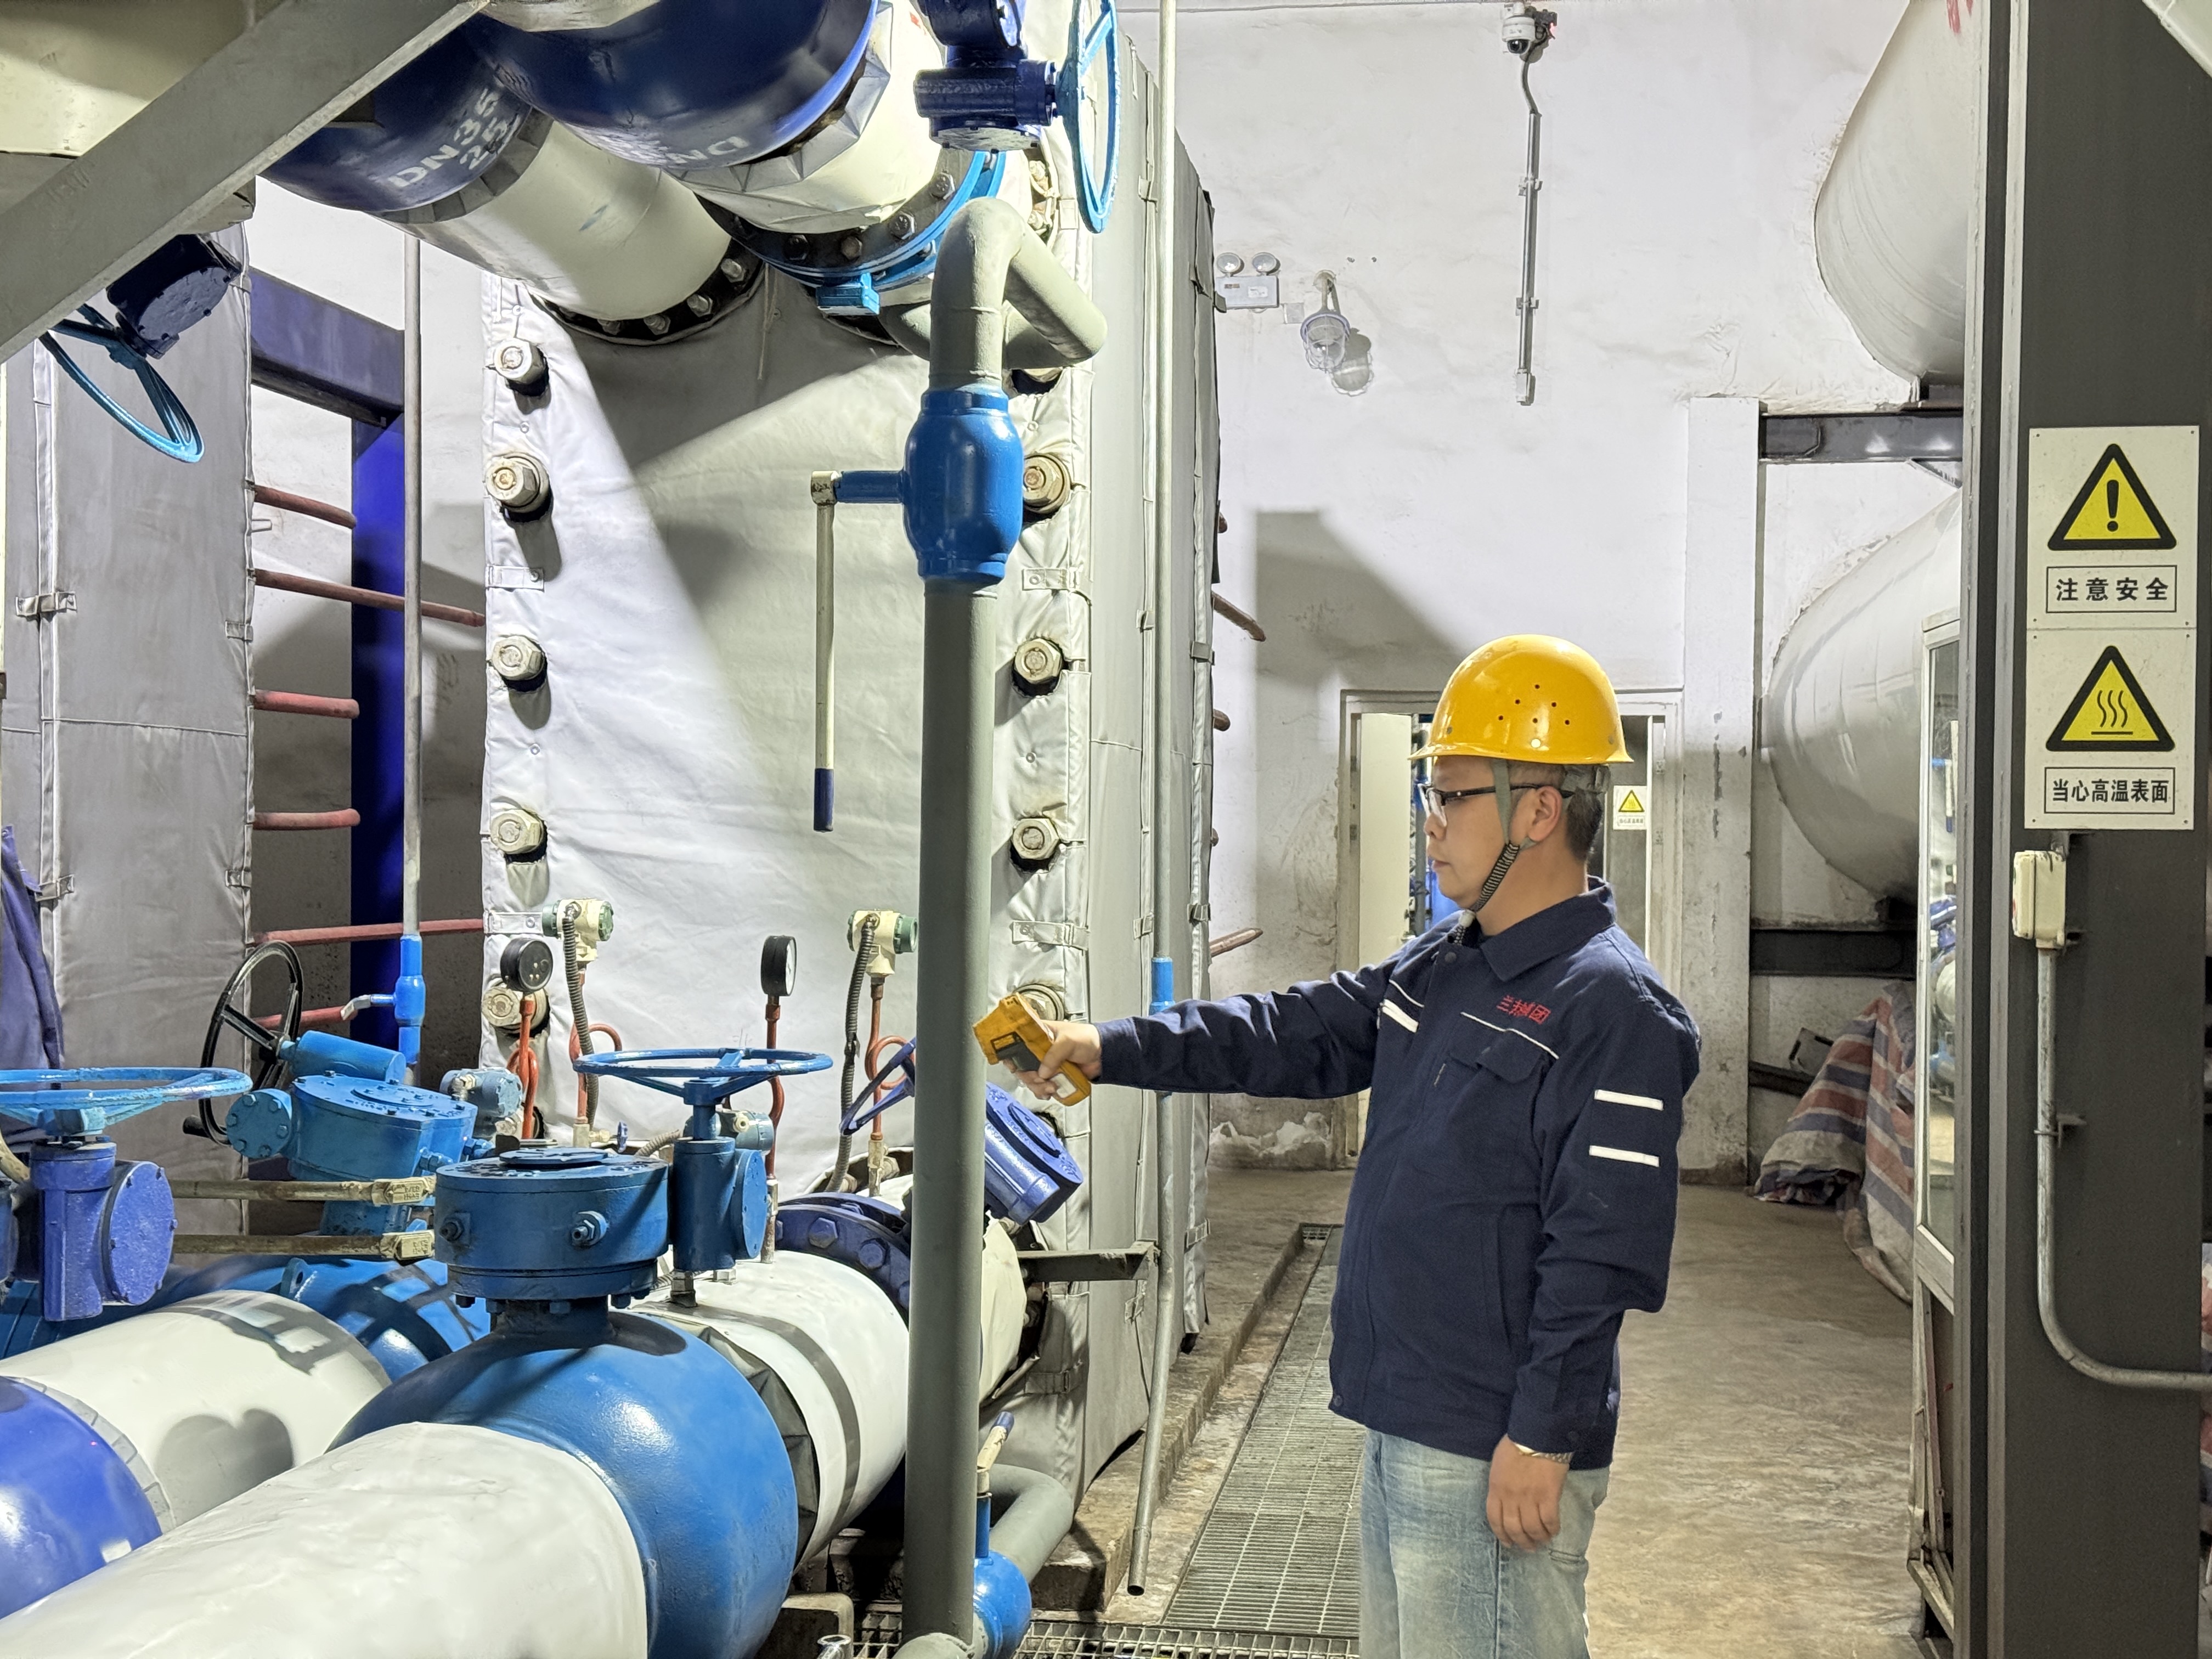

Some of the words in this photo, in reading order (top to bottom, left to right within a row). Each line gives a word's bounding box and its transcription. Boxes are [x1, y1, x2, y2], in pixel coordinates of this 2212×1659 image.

[2056, 577, 2169, 602] 注意安全
[2052, 778, 2169, 803] 当心高温表面
